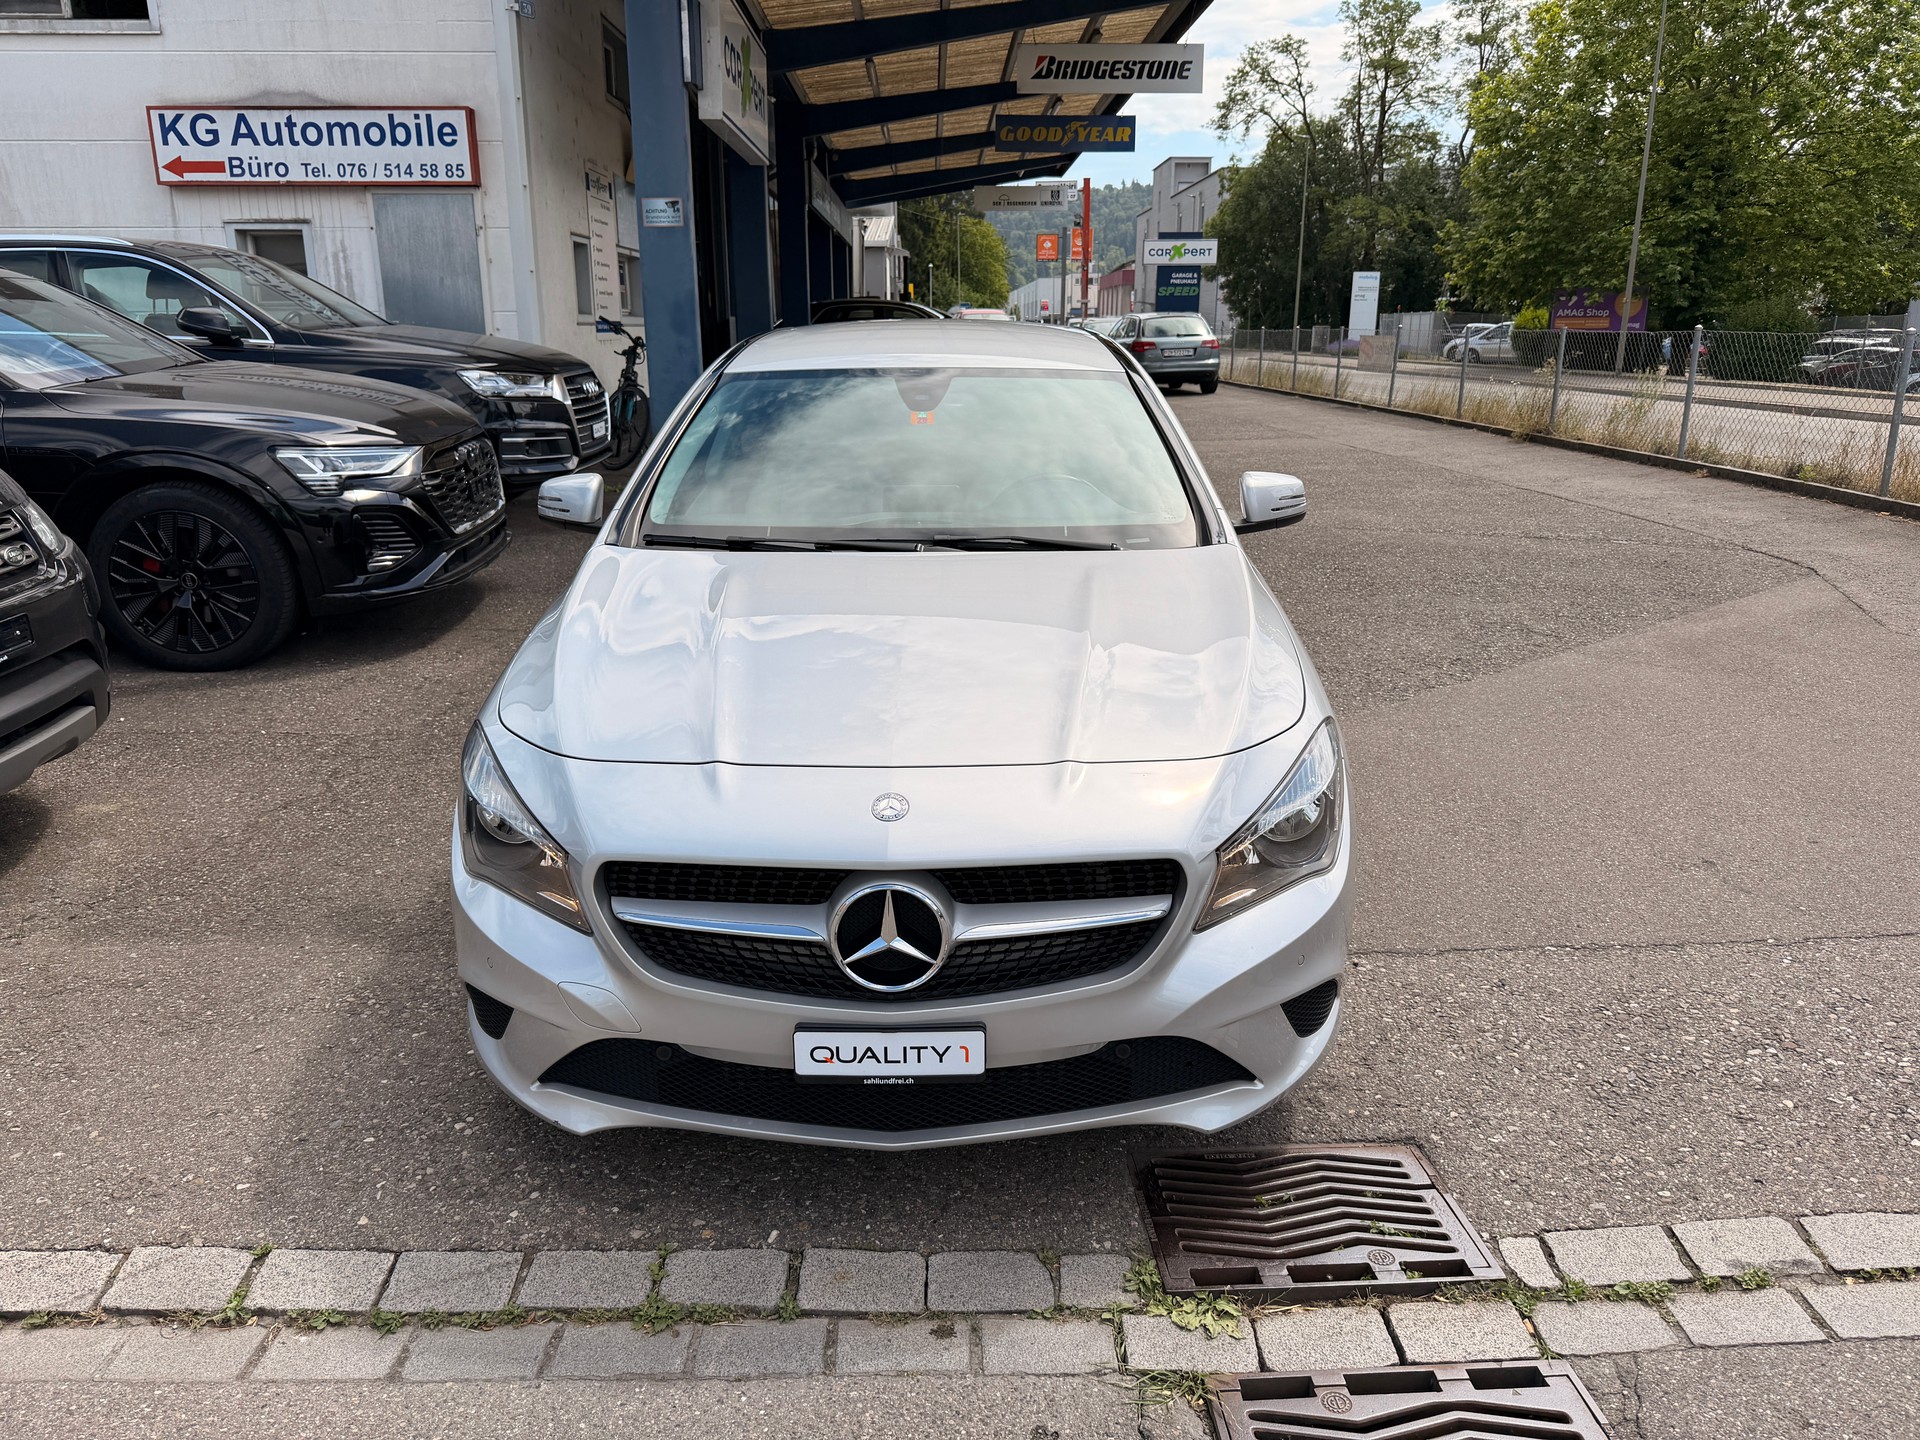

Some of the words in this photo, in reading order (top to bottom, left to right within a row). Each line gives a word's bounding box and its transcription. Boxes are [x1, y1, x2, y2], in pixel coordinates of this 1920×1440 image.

[1031, 55, 1193, 80] BRIDGESTONE
[157, 112, 220, 147] KG
[230, 112, 459, 147] Automobile
[227, 156, 290, 178] Büro
[300, 162, 331, 178] Tel.
[336, 163, 368, 178] 076
[373, 163, 378, 179] /
[383, 163, 414, 178] 514
[419, 163, 439, 178] 58
[445, 163, 466, 178] 85
[1157, 286, 1199, 296] SPEED
[1557, 308, 1584, 317] AMAG
[1586, 308, 1609, 317] Shop
[809, 1045, 952, 1064] QUALITY
[959, 1045, 970, 1063] 1
[863, 1077, 914, 1085] sahliundfrei.ch
